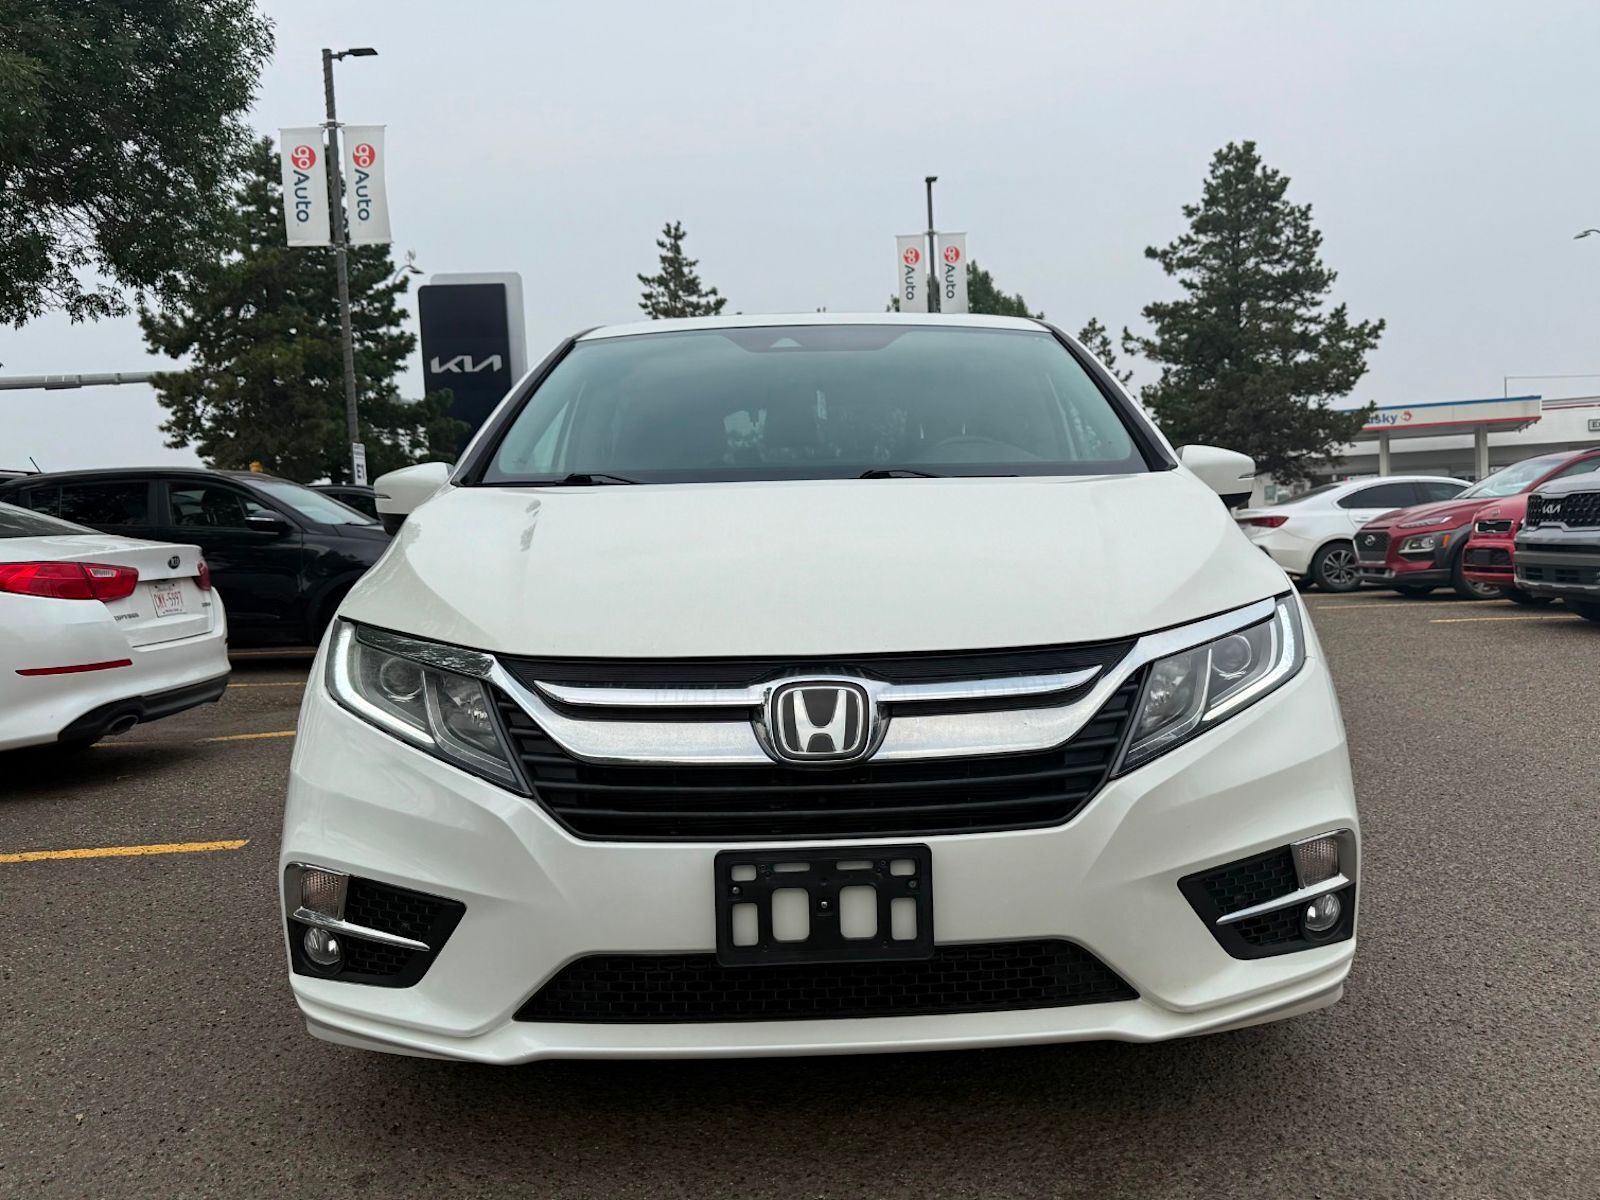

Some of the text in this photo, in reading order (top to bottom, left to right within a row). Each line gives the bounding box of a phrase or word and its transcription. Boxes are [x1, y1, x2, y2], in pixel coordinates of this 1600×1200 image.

[292, 146, 312, 222] go Auto
[353, 144, 372, 221] go Auto
[904, 265, 916, 300] Auto
[945, 264, 957, 299] Auto
[430, 354, 502, 373] KIA
